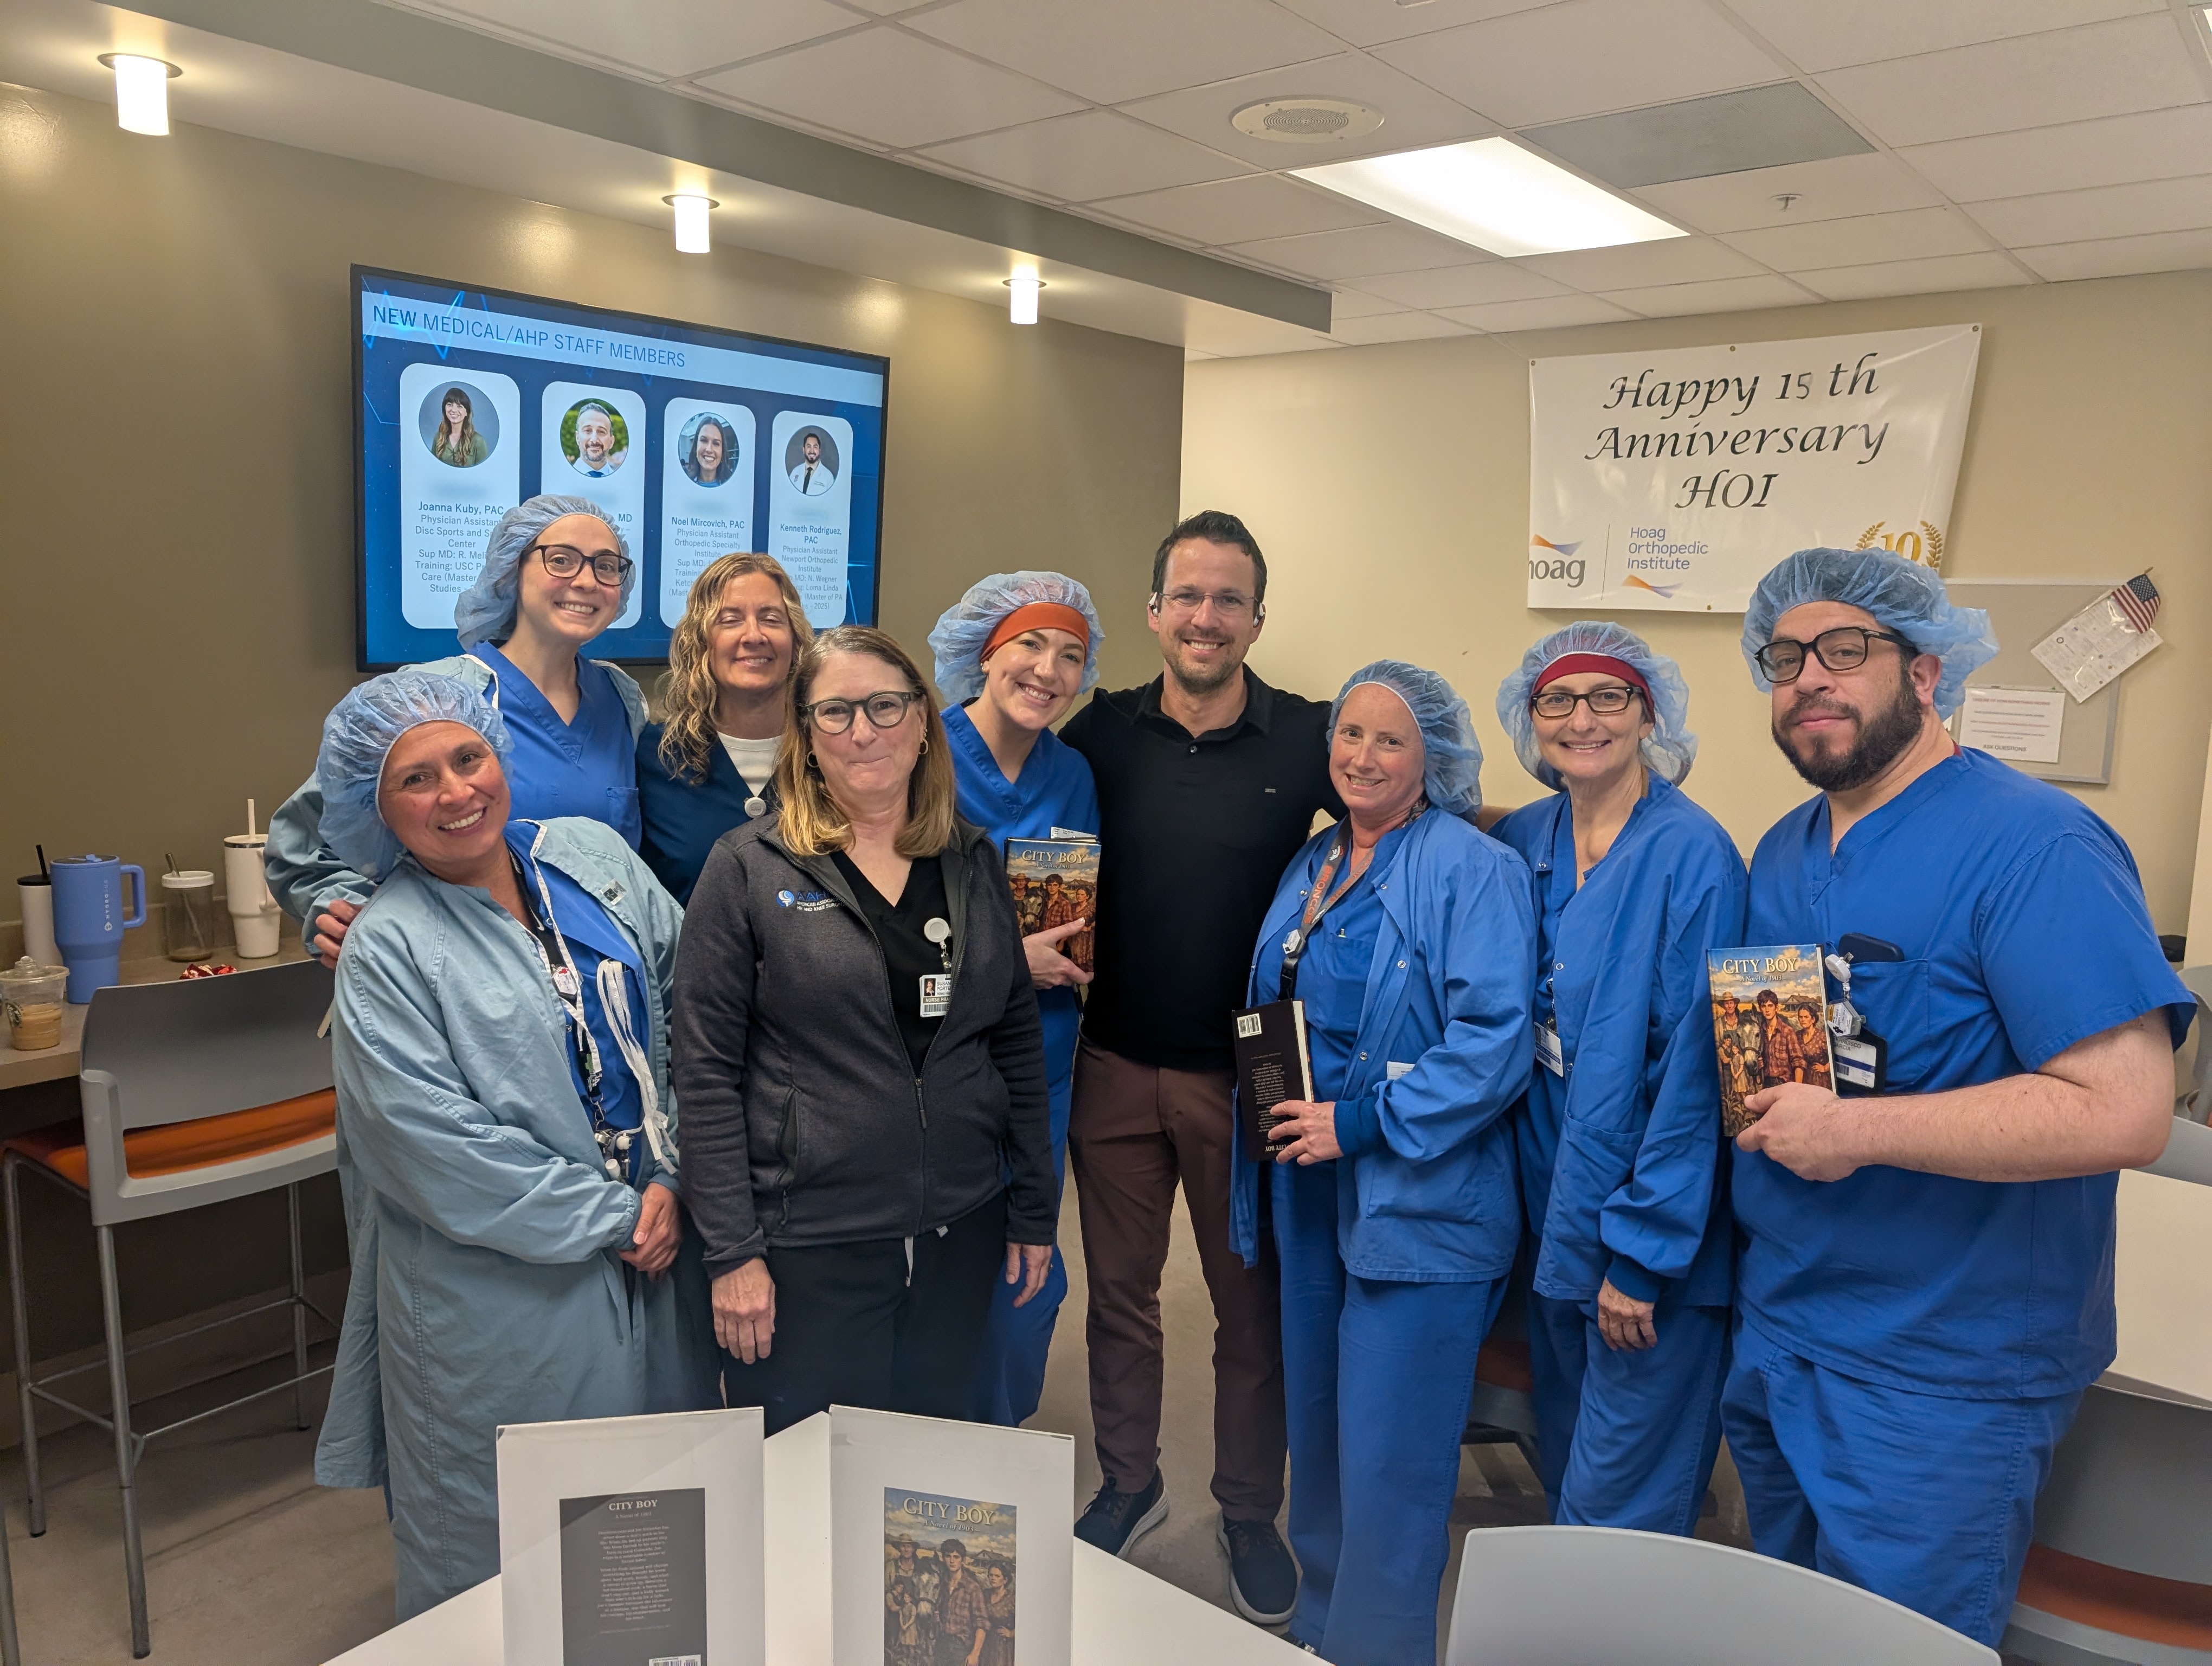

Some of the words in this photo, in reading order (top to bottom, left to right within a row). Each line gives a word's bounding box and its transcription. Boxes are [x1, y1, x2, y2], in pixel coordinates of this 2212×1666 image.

[373, 305, 416, 327] NEW
[423, 312, 549, 347] MEDICAL/AHP
[554, 334, 605, 355] STAFF
[610, 342, 685, 367] MEMBERS
[1603, 369, 1760, 420] Happy
[1775, 373, 1811, 401] 15
[1829, 352, 1879, 398] th
[1584, 420, 1891, 466] Anniversary
[1674, 468, 1779, 510] HOI
[418, 501, 452, 512] Joanna
[455, 504, 481, 515] Kuby,
[485, 505, 504, 515] PAC
[421, 515, 461, 525] Physician
[618, 514, 632, 522] MD
[672, 517, 689, 526] Noel
[691, 518, 728, 528] Mircovich,
[730, 521, 745, 529] PAC
[415, 526, 434, 535] Disc
[436, 527, 464, 537] Sports
[467, 528, 481, 536] and
[677, 529, 708, 537] Physician
[710, 530, 739, 539] Assistant
[780, 523, 807, 533] Kenneth
[809, 526, 842, 535] Rodriguez,
[1630, 527, 1666, 542] Hoag
[448, 539, 475, 548] Center
[674, 539, 710, 548] Orthopedic
[712, 541, 741, 550] Specialty
[804, 536, 818, 544] PAC
[419, 549, 435, 560] Sup
[438, 550, 455, 559] MD:
[470, 551, 487, 559] Meli
[783, 546, 810, 554] Physician
[1628, 541, 1709, 558] Orthopedic
[678, 559, 690, 567] Sup
[782, 555, 806, 563] Newport
[807, 556, 838, 564] Orthopedic
[1627, 557, 1690, 570] Institute
[415, 561, 452, 571] Training:
[455, 562, 473, 571] USC
[421, 573, 441, 581] Care
[445, 573, 477, 582] (Master
[430, 584, 461, 593] Studies
[1022, 850, 1056, 862] CITY
[1058, 852, 1085, 864] BOY
[796, 890, 827, 900] AAH
[1723, 959, 1760, 974] CITY
[1765, 958, 1797, 972] BOY
[609, 1502, 633, 1510] CITY
[636, 1500, 658, 1508] BOY
[903, 1497, 950, 1518] CITY
[956, 1505, 994, 1526] BOY
[930, 1520, 948, 1528] Novel
